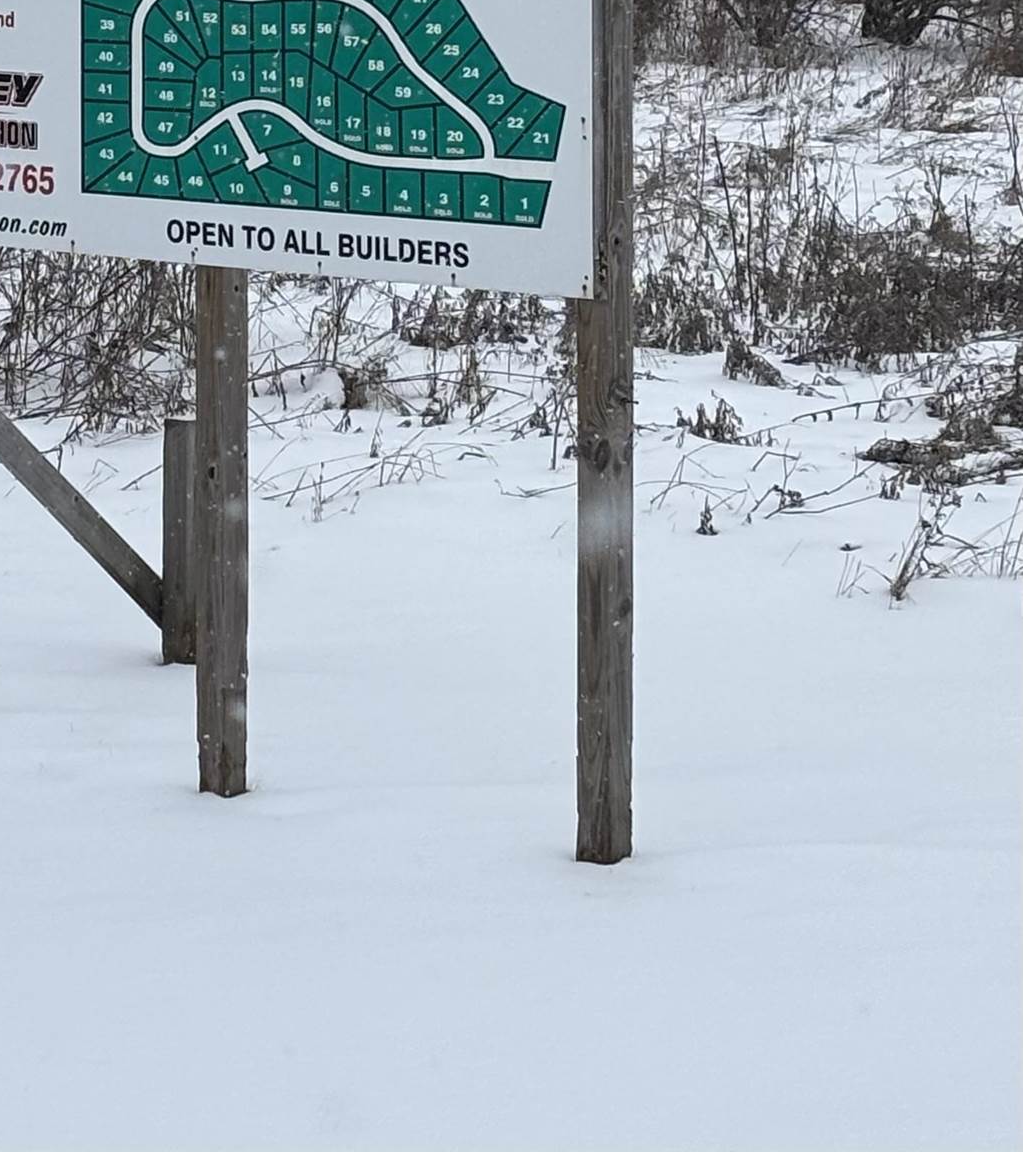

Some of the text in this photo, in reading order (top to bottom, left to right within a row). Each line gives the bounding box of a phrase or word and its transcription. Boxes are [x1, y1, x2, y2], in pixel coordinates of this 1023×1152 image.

[176, 11, 190, 21] 51
[203, 13, 218, 23] 52
[101, 20, 115, 30] 39
[231, 24, 247, 35] 53
[261, 24, 277, 35] 54
[290, 24, 306, 35] 55
[316, 24, 331, 34] 56
[426, 24, 442, 34] 26
[164, 33, 178, 43] 50
[344, 37, 360, 47] 57
[443, 45, 459, 56] 25
[99, 52, 113, 62] 40
[159, 62, 174, 72] 49
[368, 61, 384, 72] 58
[231, 70, 245, 82] 13
[262, 70, 277, 81] 14
[463, 67, 478, 78] 24
[289, 77, 304, 88] 15
[98, 84, 112, 94] 41
[201, 88, 216, 98] 12
[395, 87, 411, 97] 59
[159, 91, 174, 101] 48
[487, 94, 504, 105] 23
[317, 96, 331, 107] 16
[97, 113, 113, 123] 42
[507, 117, 524, 128] 22
[158, 122, 173, 133] 47
[262, 125, 272, 135] 7
[411, 130, 426, 140] 19
[447, 131, 463, 142] 20
[533, 133, 549, 144] 21
[99, 149, 114, 159] 43
[213, 145, 227, 155] 11
[118, 172, 133, 182] 44
[154, 175, 169, 185] 45
[188, 176, 203, 187] 46
[229, 183, 244, 194] 10
[283, 185, 292, 196] 9
[330, 182, 338, 192] 6
[361, 185, 371, 196] 5
[400, 190, 408, 200] 4
[440, 194, 448, 204] 3
[480, 195, 490, 206] 2
[520, 198, 528, 209] 1
[167, 220, 469, 268] OPEN TO ALL BUILDERS
